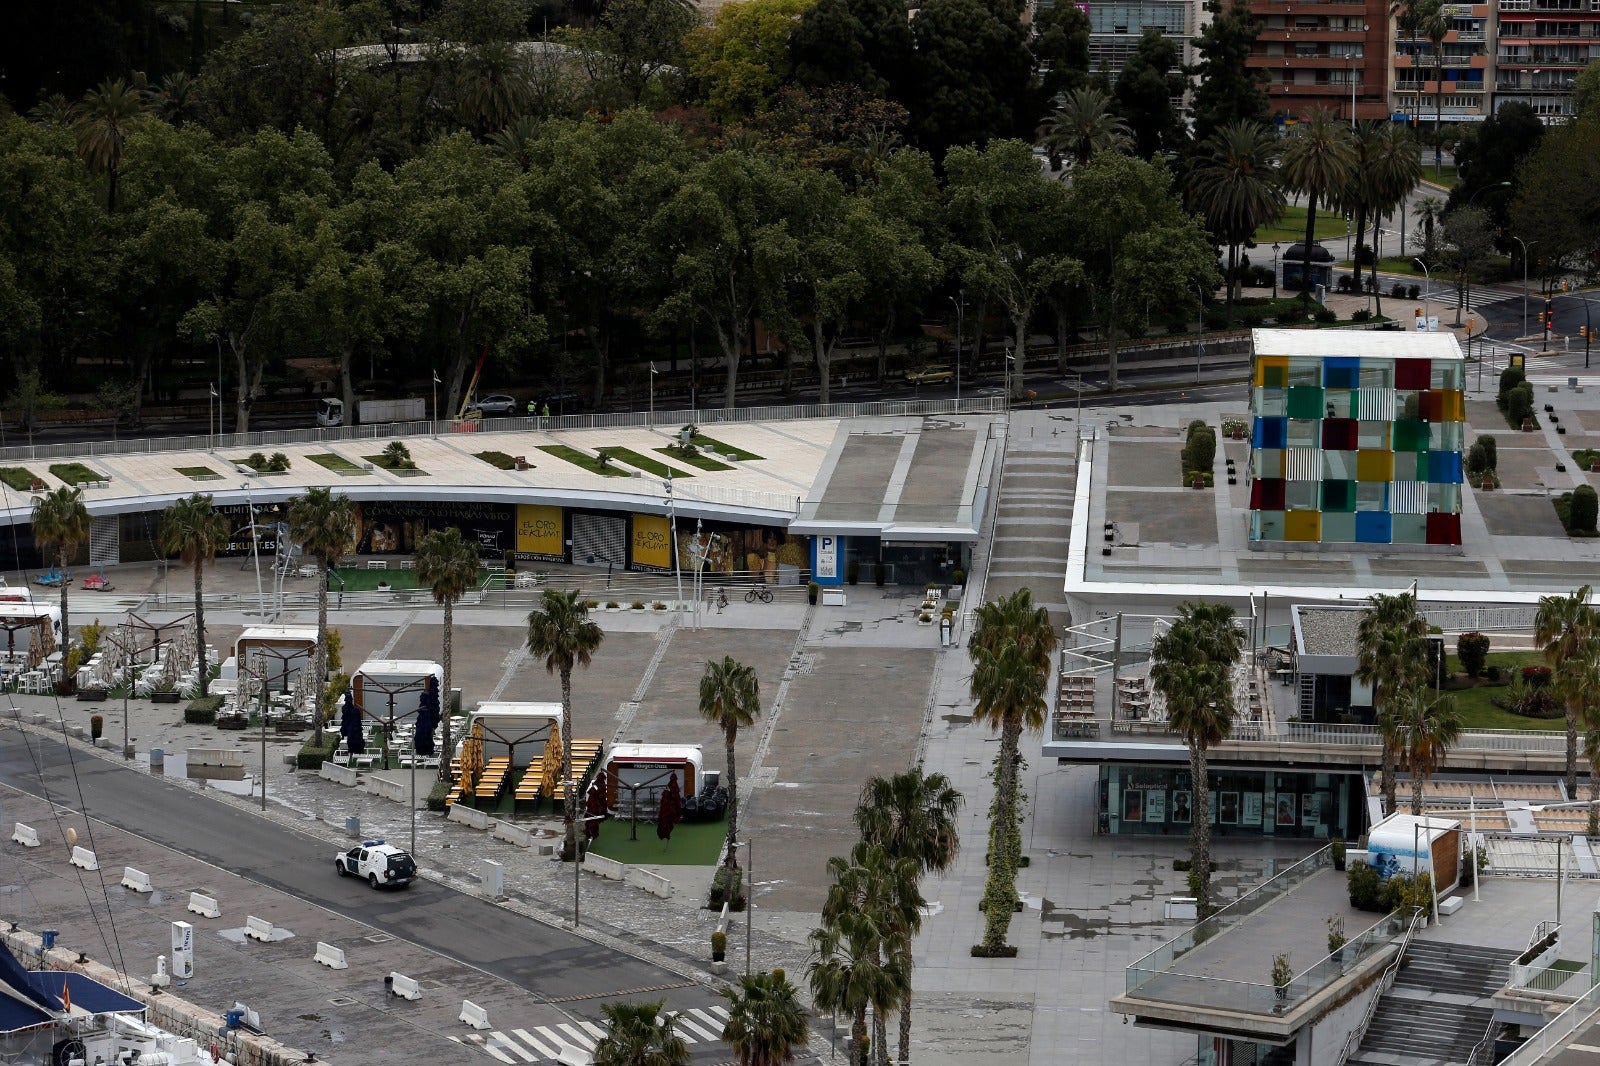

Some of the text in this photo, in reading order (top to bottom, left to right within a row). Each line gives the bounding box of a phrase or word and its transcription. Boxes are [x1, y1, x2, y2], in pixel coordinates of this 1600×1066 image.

[482, 511, 510, 520] VISTO
[536, 520, 556, 529] ORO
[529, 529, 560, 538] KLIMT
[637, 531, 664, 542] EL ORO
[642, 541, 668, 550] KLIMT
[822, 537, 832, 550] P
